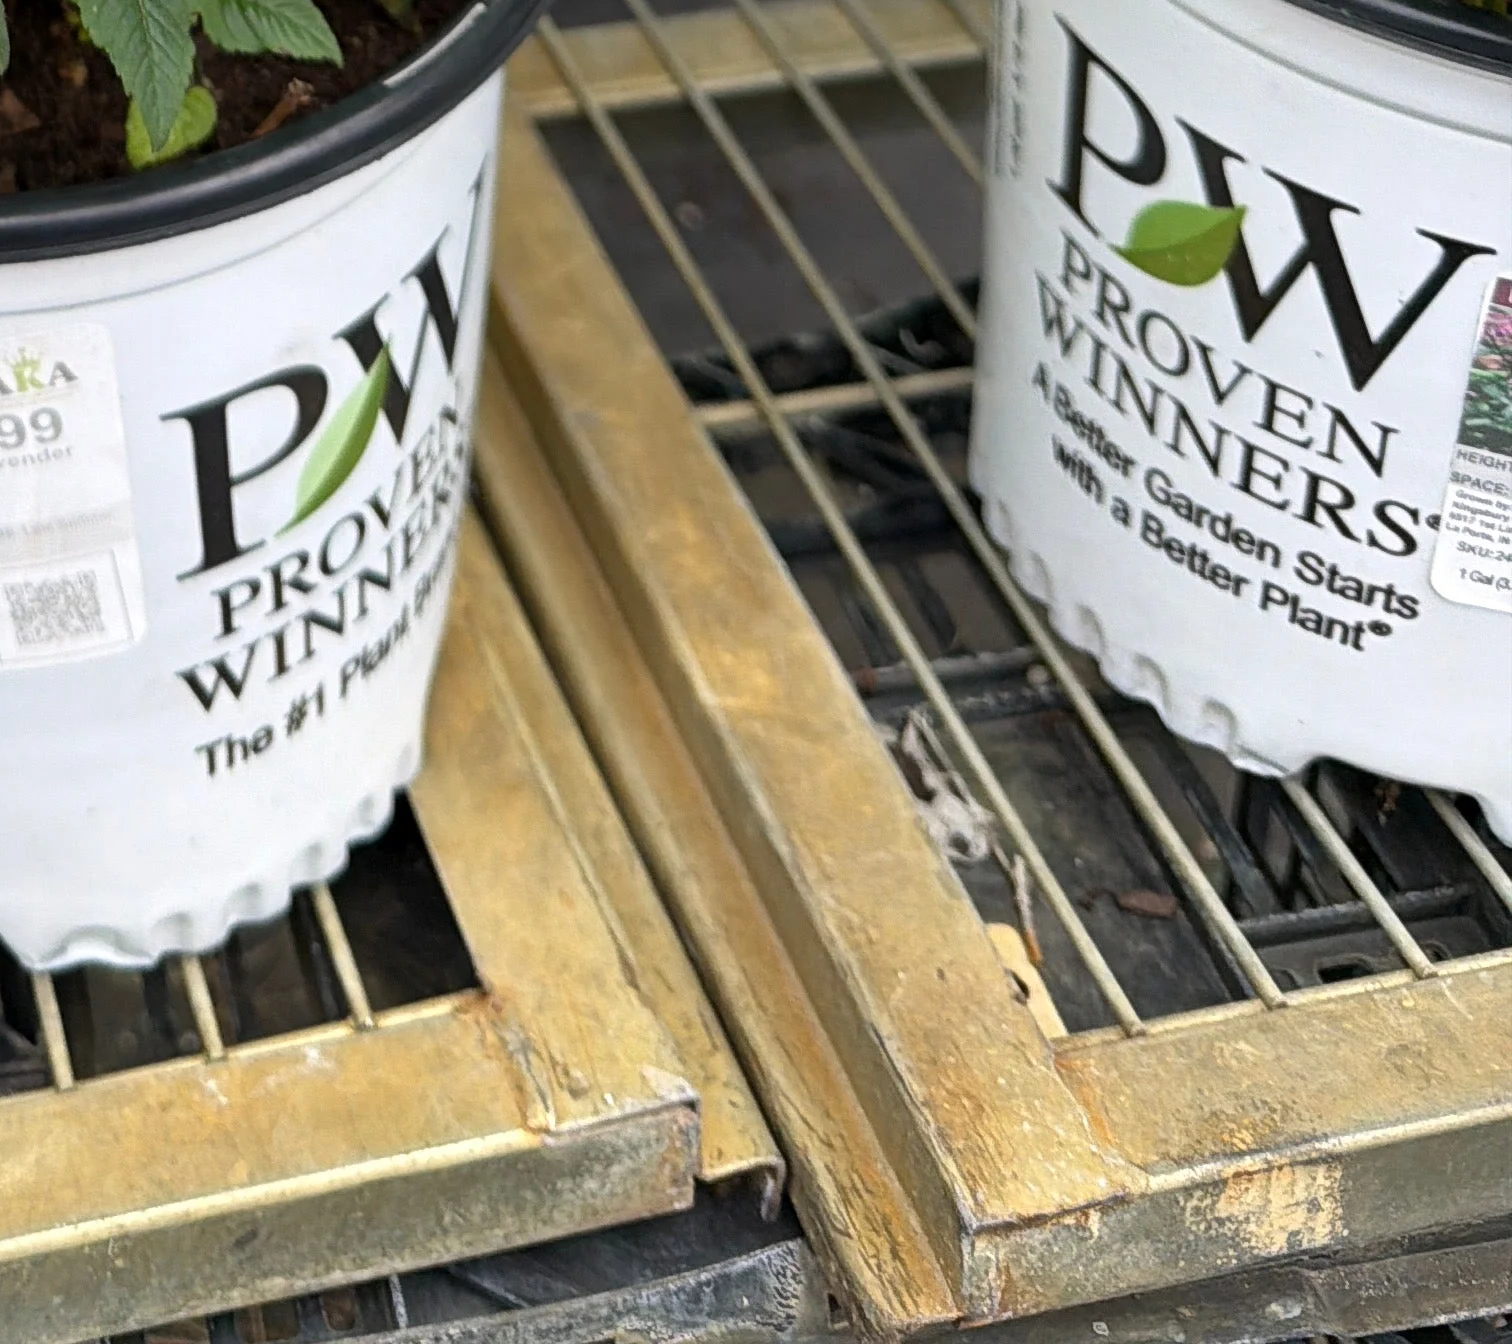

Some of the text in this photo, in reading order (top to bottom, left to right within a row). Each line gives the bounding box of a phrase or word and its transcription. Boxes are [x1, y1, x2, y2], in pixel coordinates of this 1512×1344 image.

[1047, 12, 1498, 392] PW
[1058, 226, 1399, 480] PROVEN
[1032, 360, 1420, 620] A Better Garden Starts
[1051, 433, 1106, 505] with
[1110, 495, 1132, 528] a
[1141, 508, 1251, 598] Better
[195, 603, 410, 777] The #1 Plant
